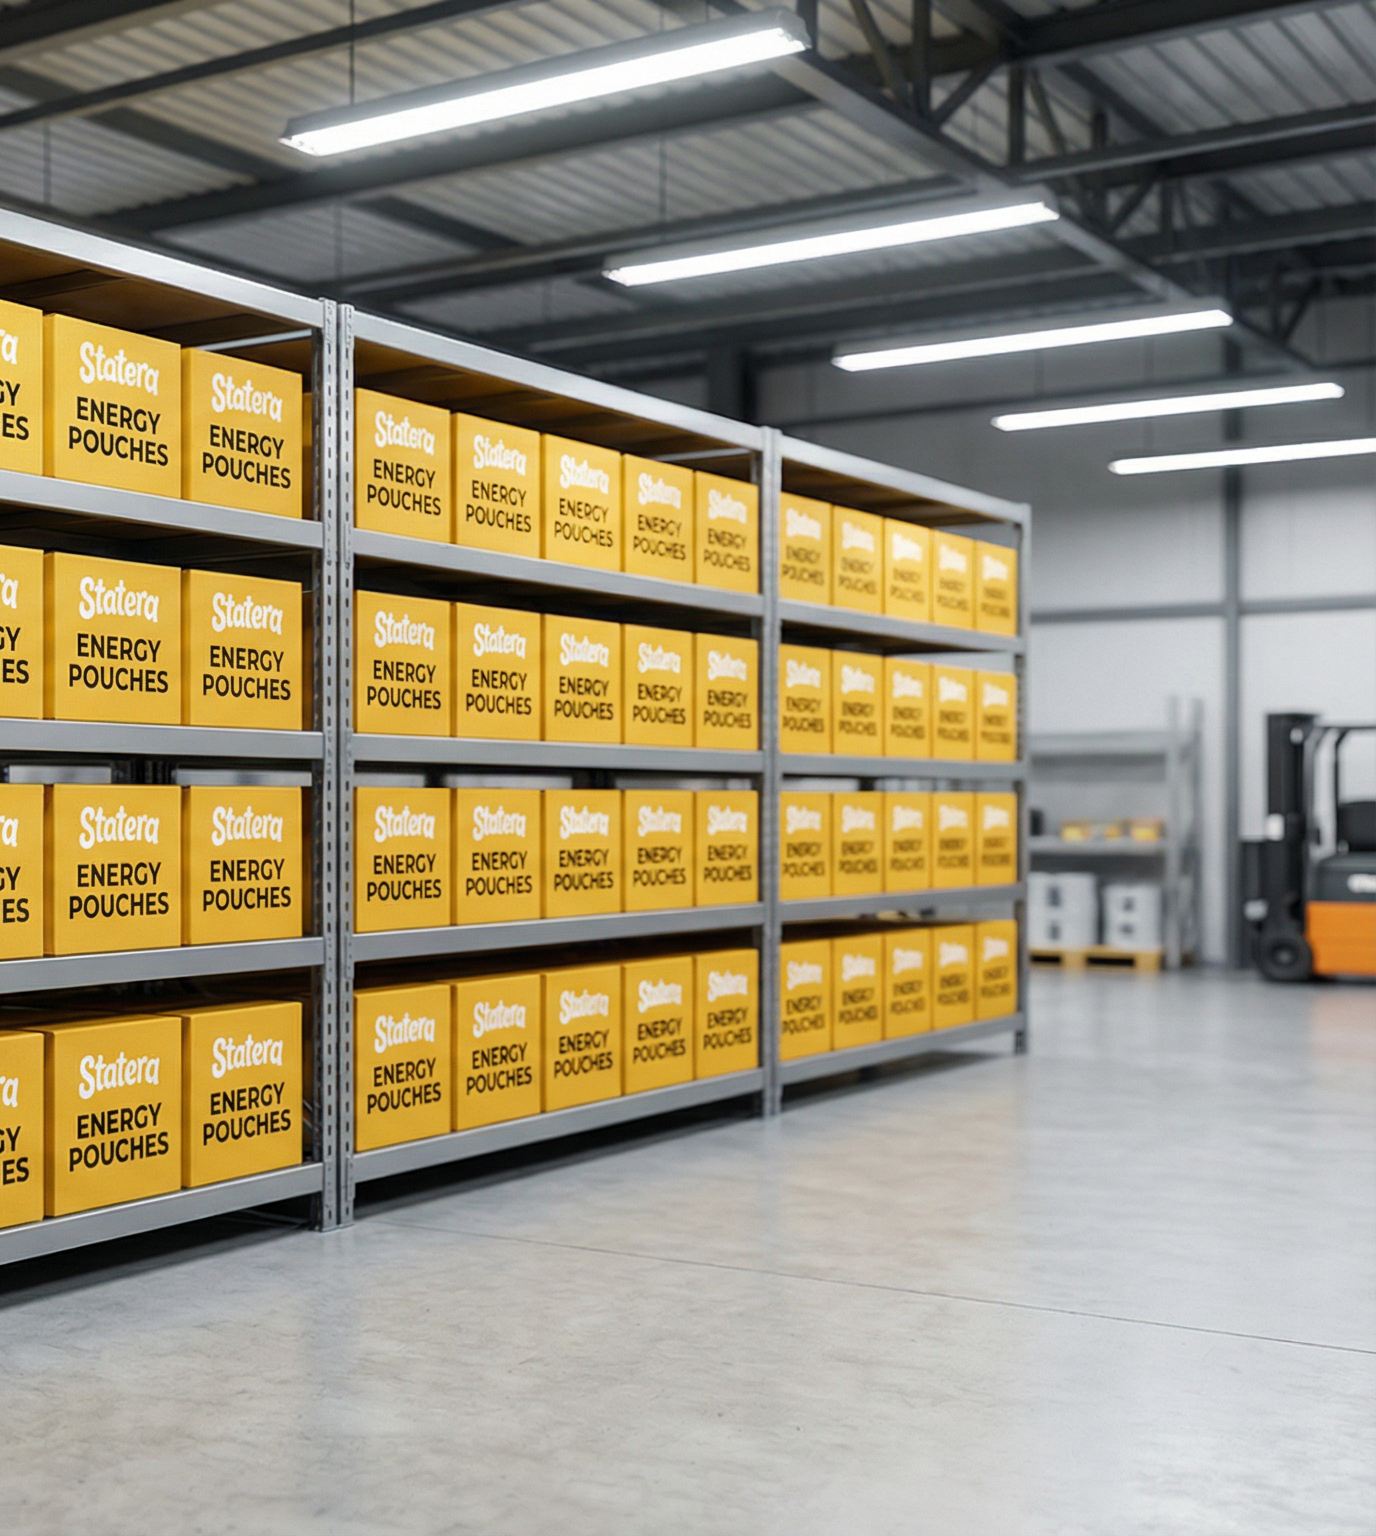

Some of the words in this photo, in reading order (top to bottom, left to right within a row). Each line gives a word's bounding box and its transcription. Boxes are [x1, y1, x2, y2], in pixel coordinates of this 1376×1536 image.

[79, 341, 160, 397] Statera
[211, 372, 283, 423] Statera
[76, 395, 161, 435] ENERGY
[68, 425, 169, 467] POUCHES
[209, 423, 285, 460] ENERGY
[373, 409, 436, 457] Statera
[472, 433, 528, 477] Statera
[202, 451, 292, 490] POUCHES
[373, 458, 436, 490] ENERGY
[367, 483, 442, 516] POUCHES
[471, 479, 527, 508] ENERGY
[465, 503, 532, 533] POUCHES
[559, 497, 609, 523] ENERGY
[554, 520, 614, 548] POUCHES
[637, 513, 682, 537] ENERGY
[633, 534, 687, 562] POUCHES
[78, 575, 160, 623] Statera
[211, 591, 283, 636] Statera
[373, 610, 435, 651] Statera
[473, 622, 527, 659] Statera
[77, 632, 162, 663] ENERGY
[209, 644, 285, 673] ENERGY
[68, 663, 169, 694] POUCHES
[373, 659, 437, 684] ENERGY
[471, 668, 528, 691] ENERGY
[558, 675, 610, 697] ENERGY
[202, 673, 292, 701] POUCHES
[366, 685, 442, 710] POUCHES
[637, 682, 683, 703] ENERGY
[465, 692, 532, 716] POUCHES
[553, 698, 614, 721] POUCHES
[632, 704, 687, 726] POUCHES
[79, 805, 160, 850] Statera
[211, 805, 284, 847] Statera
[373, 805, 436, 843] Statera
[472, 805, 527, 841] Statera
[373, 853, 437, 875] ENERGY
[471, 850, 528, 872] ENERGY
[558, 848, 609, 869] ENERGY
[637, 845, 683, 866] ENERGY
[77, 861, 162, 888] ENERGY
[210, 858, 285, 883] ENERGY
[553, 870, 614, 892] POUCHES
[632, 867, 687, 887] POUCHES
[202, 885, 292, 912] POUCHES
[366, 878, 442, 902] POUCHES
[465, 874, 533, 897] POUCHES
[69, 891, 170, 920] POUCHES
[374, 1012, 436, 1054] Statera
[472, 999, 526, 1039] Statera
[636, 1017, 683, 1042] ENERGY
[211, 1033, 284, 1079] Statera
[471, 1042, 528, 1070] ENERGY
[558, 1029, 610, 1055] ENERGY
[632, 1037, 687, 1064] POUCHES
[78, 1051, 160, 1100] Statera
[373, 1057, 437, 1088] ENERGY
[553, 1050, 614, 1079] POUCHES
[466, 1065, 533, 1096] POUCHES
[210, 1081, 285, 1116] ENERGY
[366, 1081, 442, 1115] POUCHES
[77, 1102, 162, 1140] ENERGY
[202, 1108, 292, 1147] POUCHES
[69, 1131, 170, 1173] POUCHES
